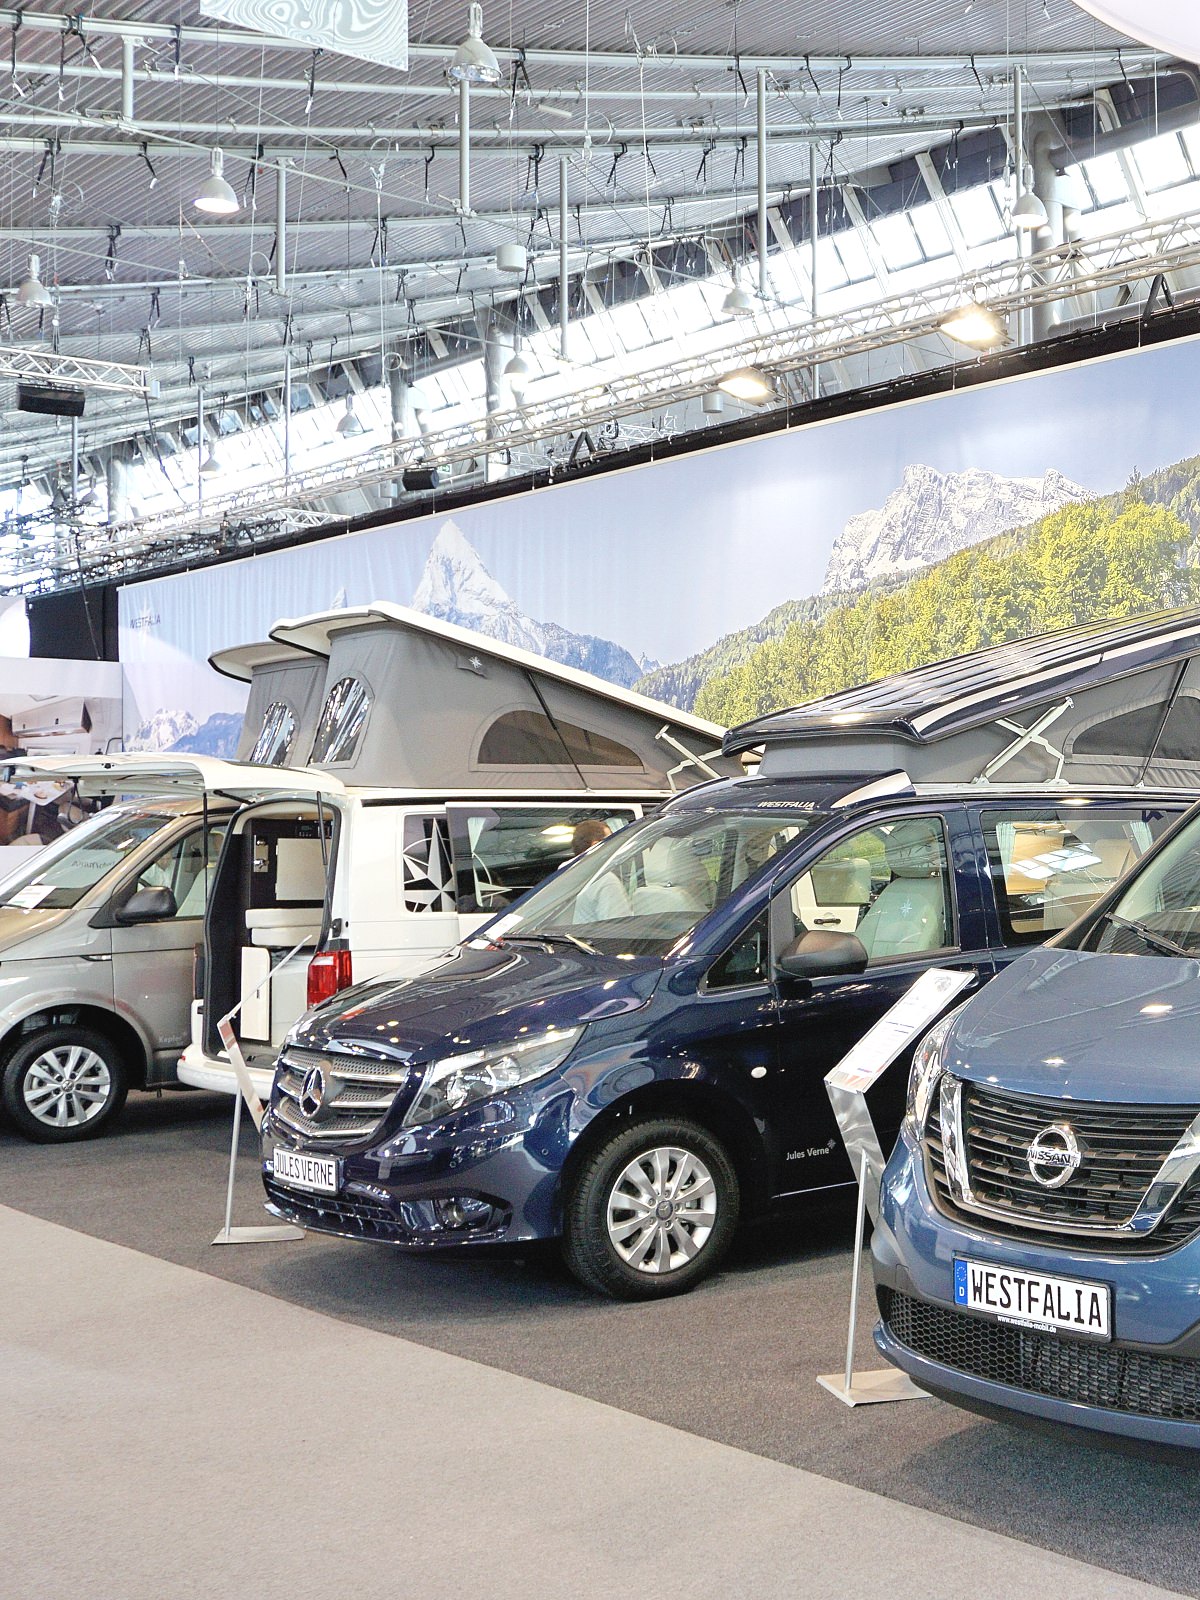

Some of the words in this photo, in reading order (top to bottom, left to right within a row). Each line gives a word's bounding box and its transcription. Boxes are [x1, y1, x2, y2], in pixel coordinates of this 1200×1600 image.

[786, 1150, 805, 1160] Jules
[806, 1147, 830, 1157] Verne
[1028, 1149, 1071, 1164] NISSAN
[275, 1152, 300, 1179] JULES
[301, 1158, 334, 1187] VERNE
[958, 1286, 965, 1297] D
[971, 1268, 1102, 1328] WESTFALIA
[996, 1315, 1057, 1334] www.westfalia-mobil.de
